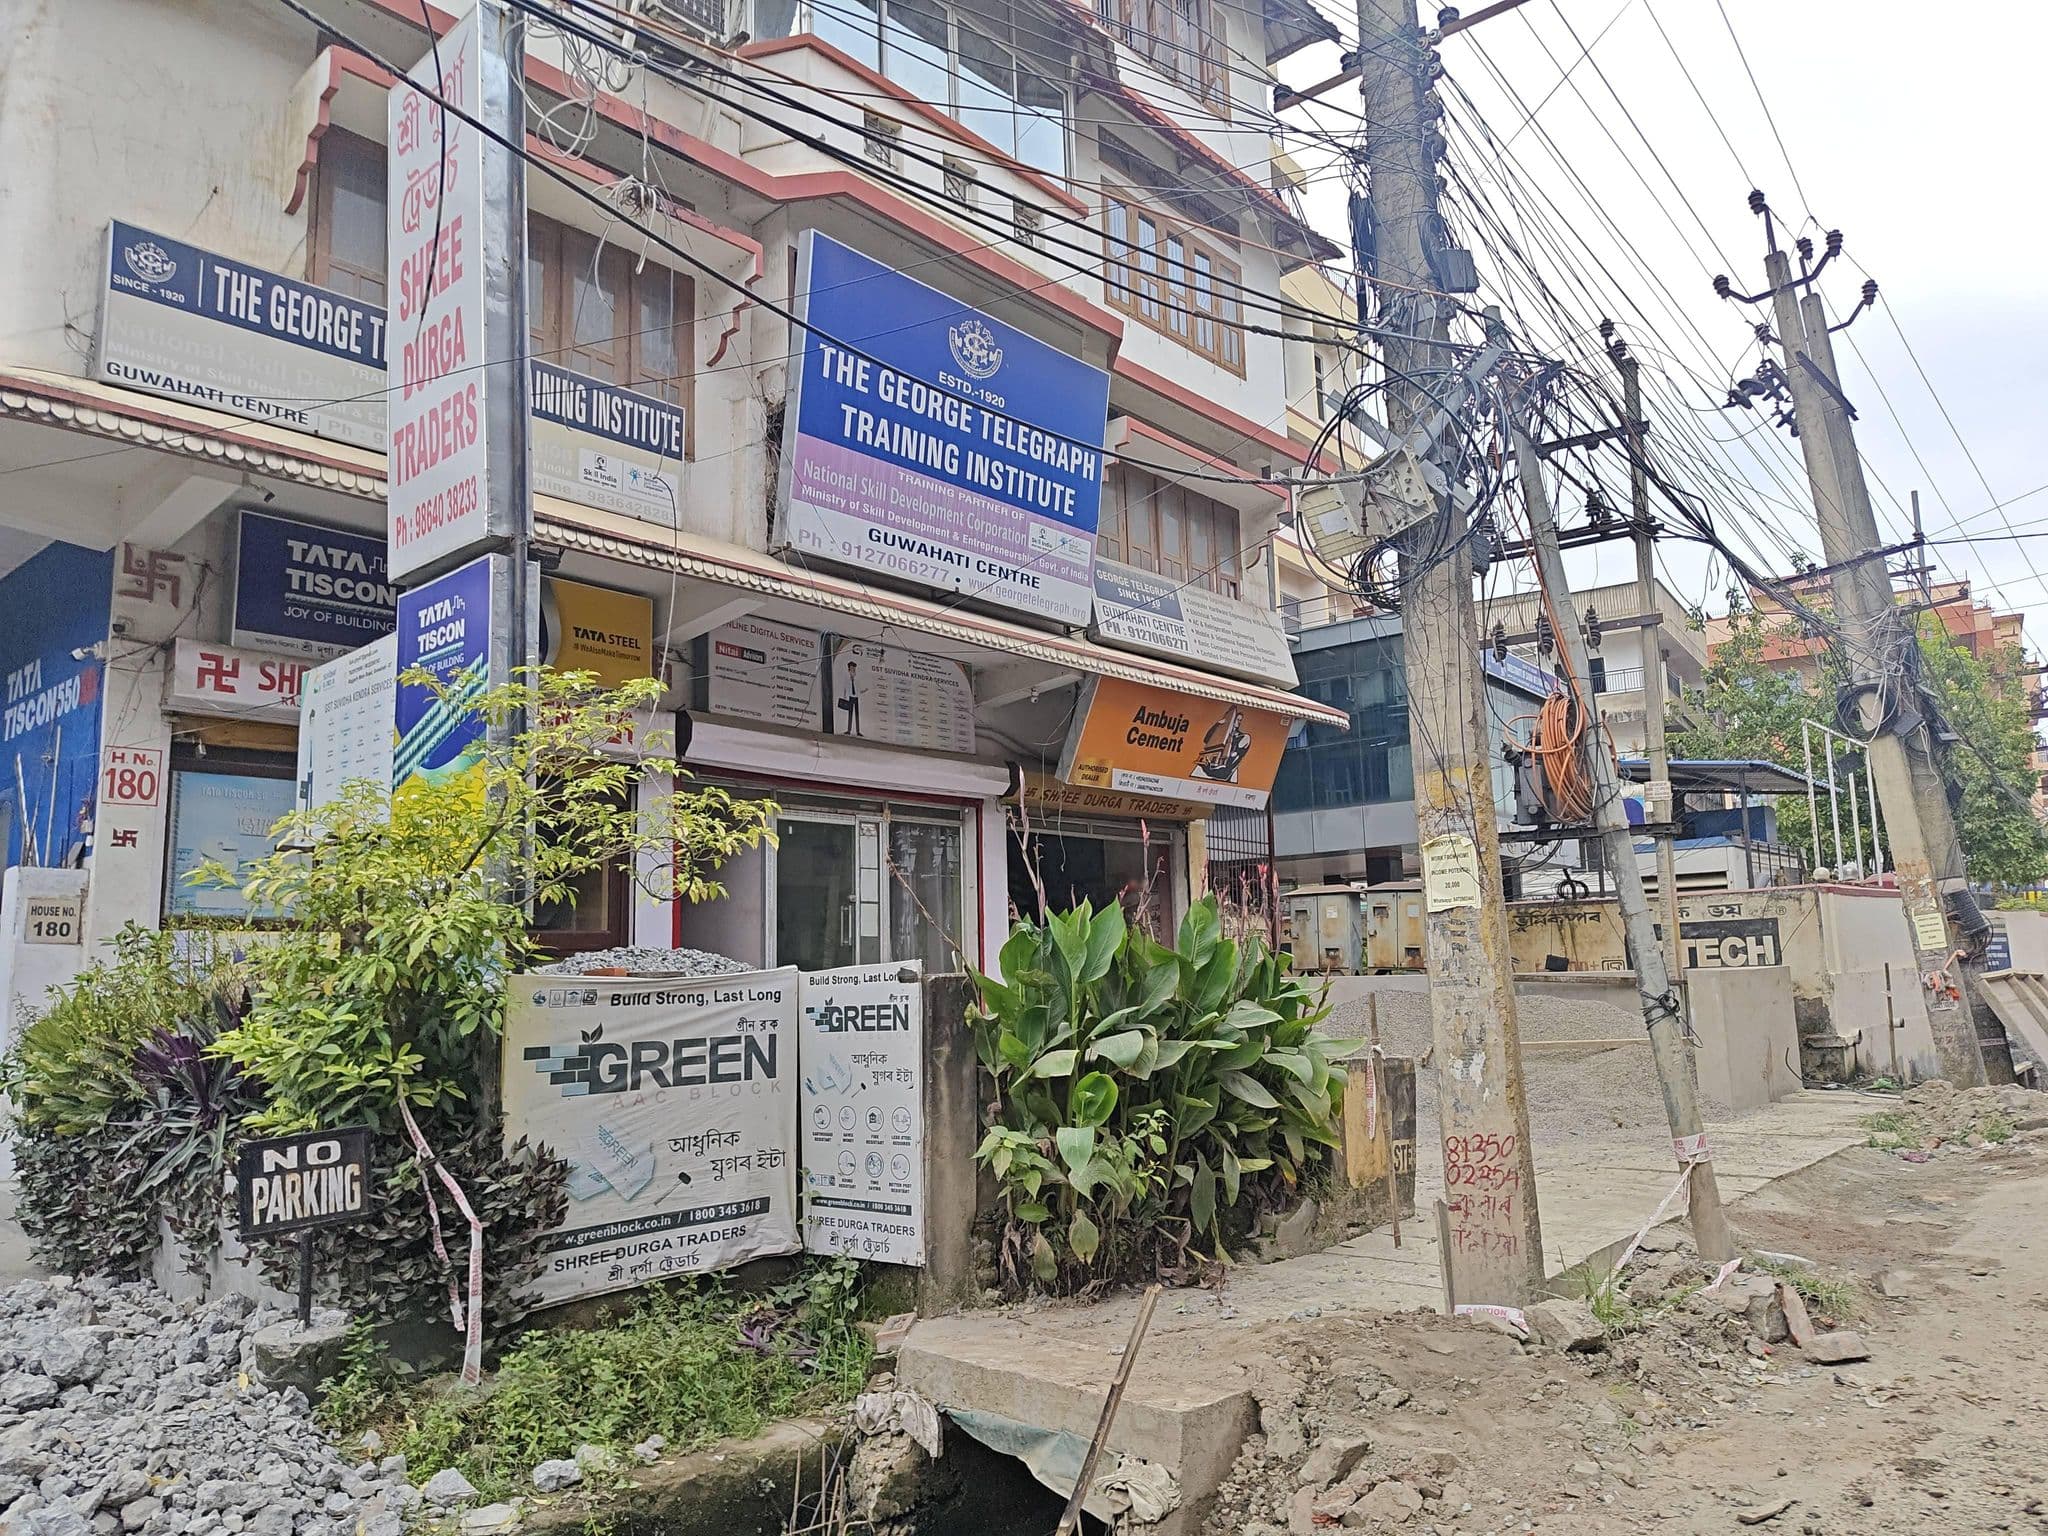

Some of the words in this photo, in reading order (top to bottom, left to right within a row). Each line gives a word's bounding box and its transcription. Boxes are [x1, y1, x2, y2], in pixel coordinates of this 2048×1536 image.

[400, 215, 463, 322] SHREE
[113, 274, 149, 294] SINCE
[159, 287, 185, 304] 1920
[214, 265, 263, 324] THE
[270, 284, 362, 354] GEORGE
[403, 306, 466, 401] DURGA
[106, 361, 223, 403] GUWAHATI
[231, 394, 309, 426] CENTRE
[938, 371, 1006, 409] ESTD.-1920
[592, 389, 681, 453] INSTITUTE
[819, 344, 869, 394] THE
[879, 370, 972, 433] GEORGE
[980, 409, 1096, 481] TELEGRAPH
[394, 382, 478, 487] TRADERS
[840, 404, 959, 475] TRAINING
[966, 452, 1076, 517] INSTITUTE
[396, 513, 407, 549] Ph
[415, 497, 443, 538] 98640
[447, 475, 477, 526] 38233
[803, 460, 857, 491] National
[860, 477, 888, 500] Skill
[890, 489, 964, 526] Development
[967, 510, 1027, 545] Corporation
[898, 471, 955, 499] TRAINING
[958, 491, 1008, 516] PARTNER
[1011, 509, 1026, 521] OF
[801, 485, 847, 510] Ministry
[849, 498, 860, 512] of
[862, 503, 885, 521] Skill
[888, 510, 950, 539] Development
[952, 529, 960, 541] &
[1070, 569, 1089, 582] India
[287, 539, 368, 574] TATA
[799, 529, 823, 549] Ph
[841, 540, 949, 582] 9127066277
[868, 527, 970, 569] GUWAHATI
[976, 559, 1041, 590] CENTRE
[286, 567, 397, 607] TISCON
[1096, 569, 1130, 588] GEORGE
[1117, 587, 1140, 602] SINCE
[284, 605, 310, 620] JOY
[314, 608, 332, 622] OF
[335, 614, 396, 633] BUILDING
[418, 598, 451, 628] TATA
[1102, 605, 1151, 627] GUWAHATI
[1152, 620, 1185, 637] CENTRE
[1106, 622, 1120, 634] PH
[417, 618, 465, 654] TISCON
[573, 626, 606, 643] TATA
[608, 634, 641, 650] STEEL
[437, 652, 465, 672] BUILDING
[7, 658, 42, 703] TATA
[1133, 706, 1190, 734] Ambuja
[1127, 727, 1184, 753] Cement
[105, 768, 156, 800] 180
[1081, 772, 1100, 783] DEALER
[1041, 788, 1079, 806] SHREE
[1083, 793, 1122, 810] DURGA
[1128, 800, 1181, 816] TRADERS
[30, 905, 60, 917] HOUSE
[62, 906, 77, 917] NO.
[33, 921, 71, 938] 180
[809, 976, 830, 986] Build
[832, 975, 861, 986] Strong,
[863, 973, 882, 983] Last
[610, 992, 650, 1007] Build
[656, 991, 709, 1006] Strong,
[714, 990, 745, 1003] Last
[749, 988, 781, 1003] Long
[826, 1004, 909, 1032] GREEN
[589, 1033, 777, 1094] GREEN
[612, 1091, 667, 1109] AAC
[690, 1080, 781, 1101] BLOCK
[262, 1140, 342, 1173] NO
[1446, 1133, 1515, 1164] 81350
[252, 1163, 361, 1226] PARKING
[689, 1208, 716, 1222] 1800
[719, 1205, 737, 1218] 345
[740, 1200, 761, 1214] 3618
[838, 1218, 869, 1231] DURGA
[871, 1222, 915, 1237] TRADERS
[553, 1251, 612, 1273] SHREE
[616, 1238, 673, 1260] DURGA
[677, 1225, 747, 1248] TRADERS
